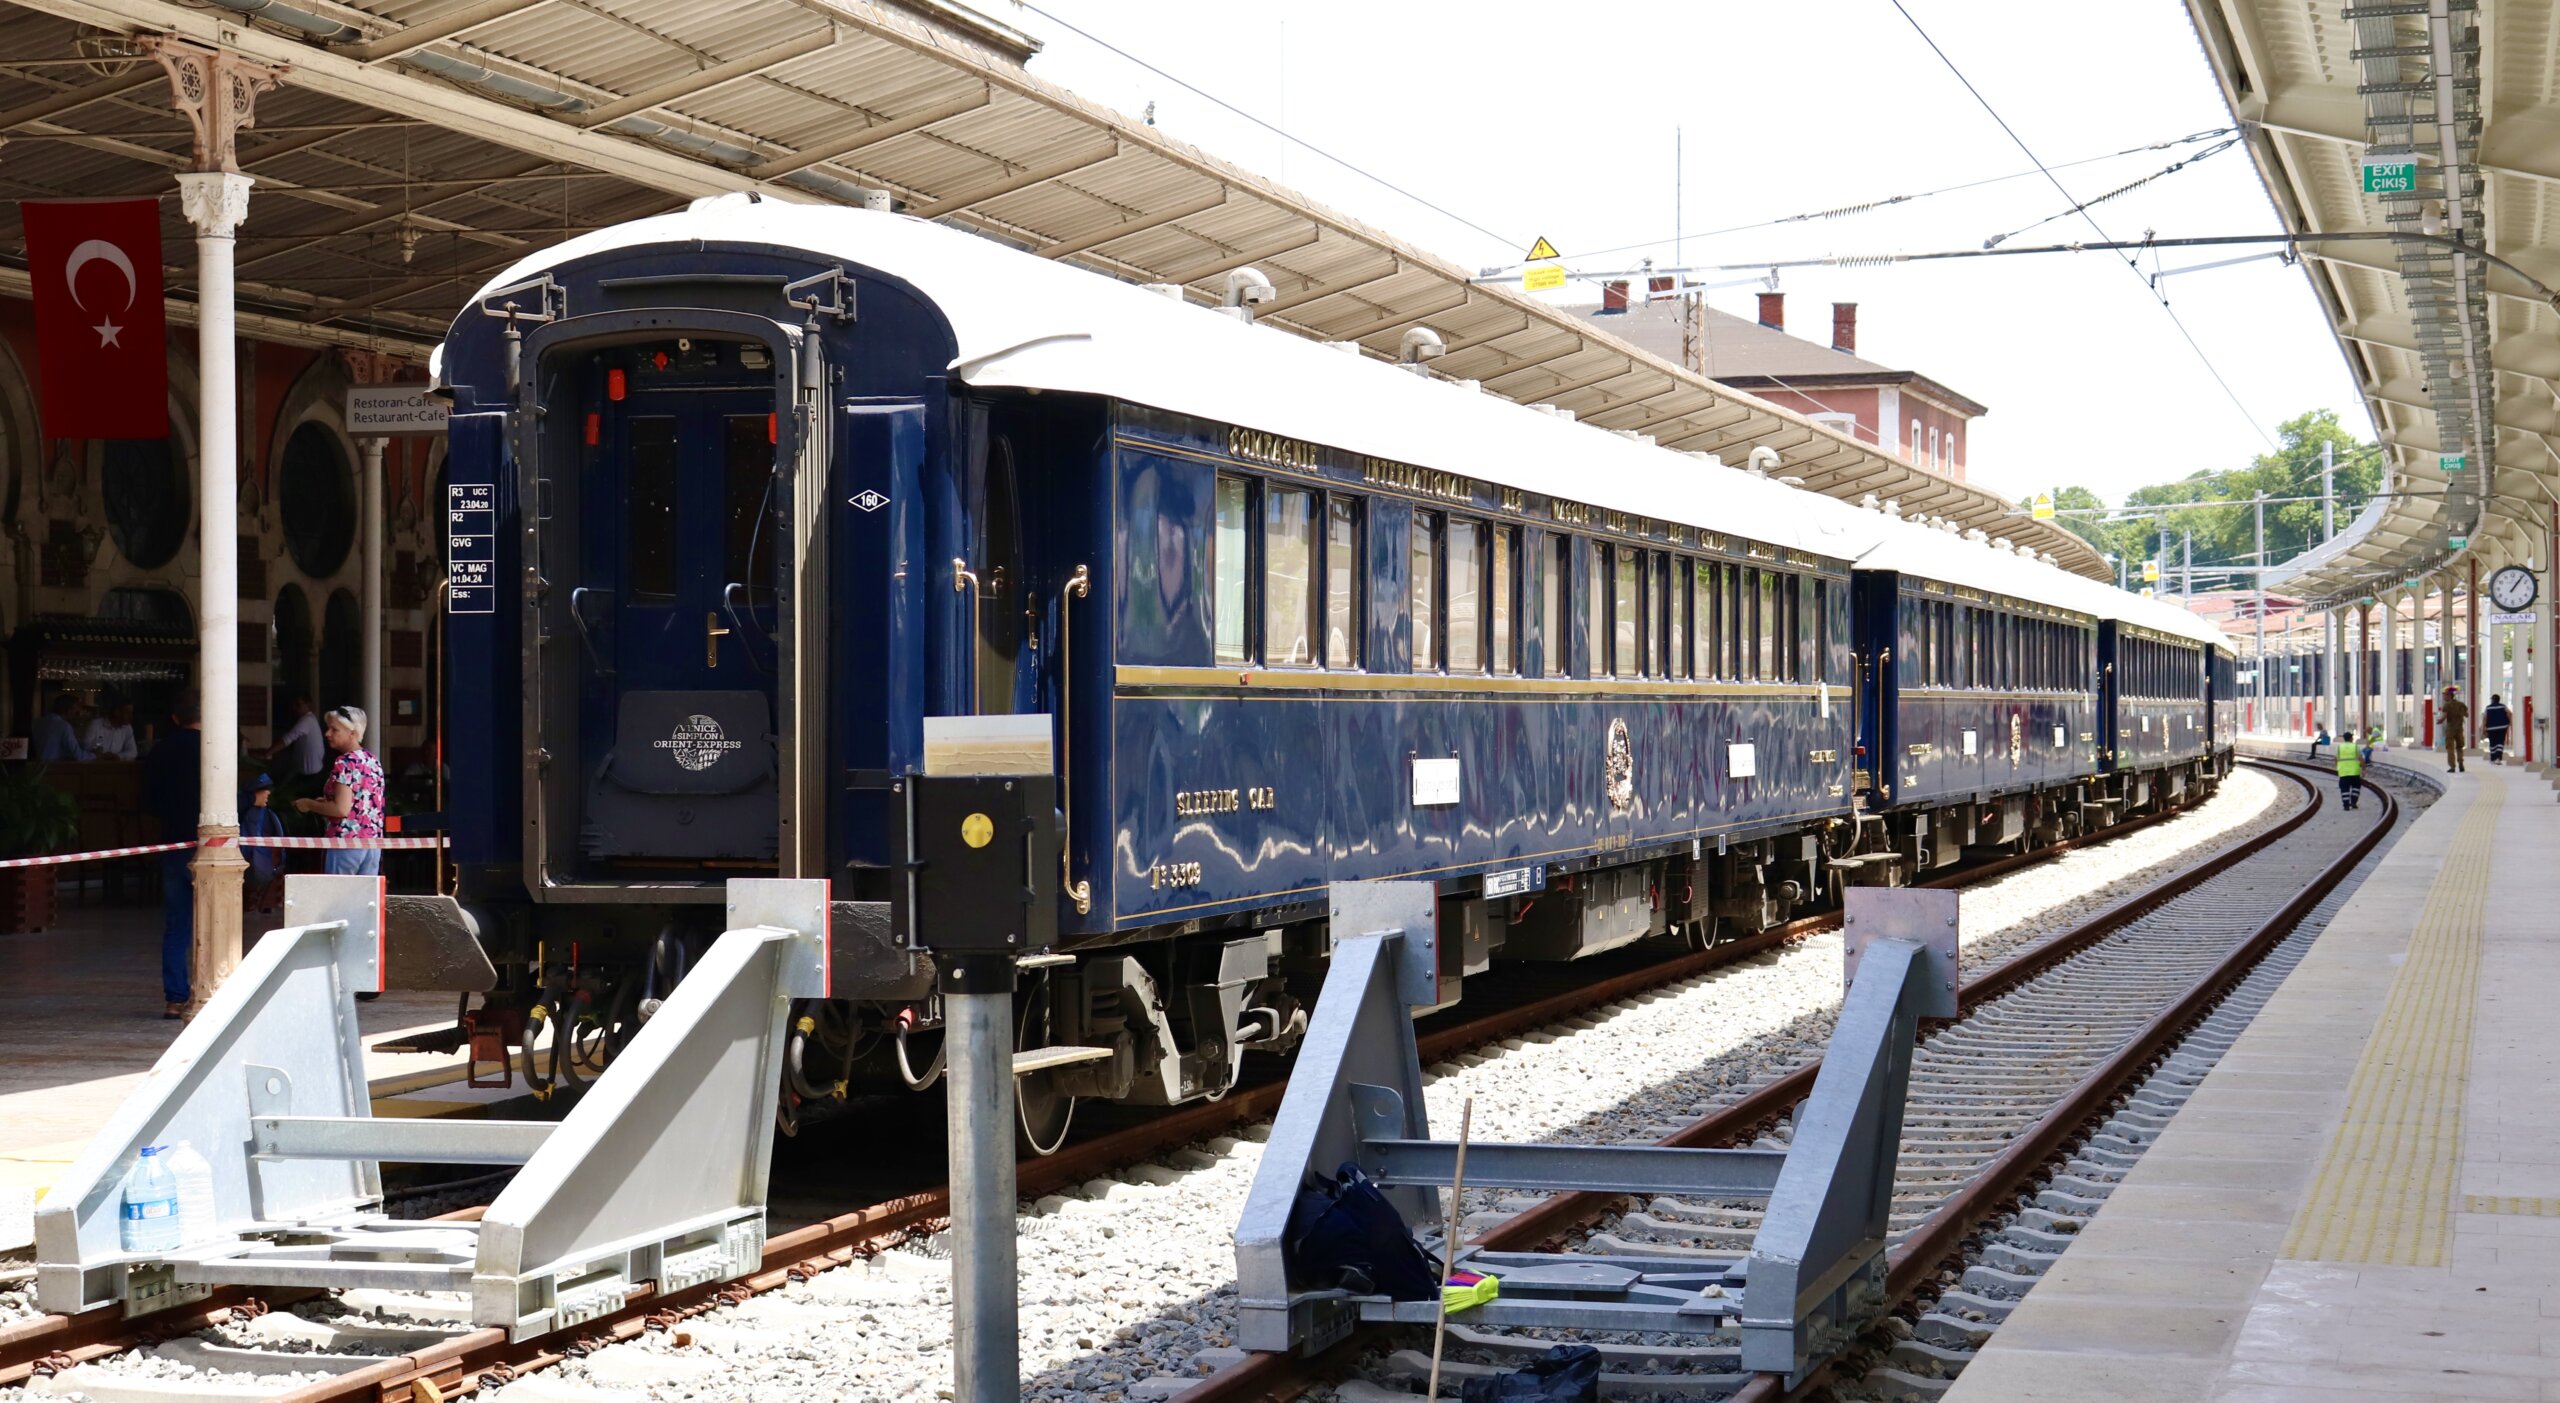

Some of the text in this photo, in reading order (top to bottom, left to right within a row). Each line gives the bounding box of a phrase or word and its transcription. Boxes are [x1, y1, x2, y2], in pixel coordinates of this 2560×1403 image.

[2373, 165, 2406, 176] EXIT
[2372, 178, 2407, 191] ÇIKIŞ
[354, 411, 445, 424] Restaurant-Cafe
[1229, 426, 1318, 472] COMPAGNIE
[1364, 457, 1473, 502] INTERNATIONALE
[452, 488, 463, 496] R3
[460, 500, 488, 509] 23.04.20
[861, 495, 878, 506] 160
[452, 513, 464, 522] R2
[452, 538, 472, 547] GVG
[452, 564, 488, 572] VC MAG
[452, 575, 482, 583] 01.04.24
[452, 589, 471, 598] Ess:
[680, 724, 717, 732] VENICE
[677, 732, 718, 740] SIMPLON
[653, 740, 742, 749] ORIENT-EXPRESS
[1176, 786, 1274, 815] SLEEPING CAR
